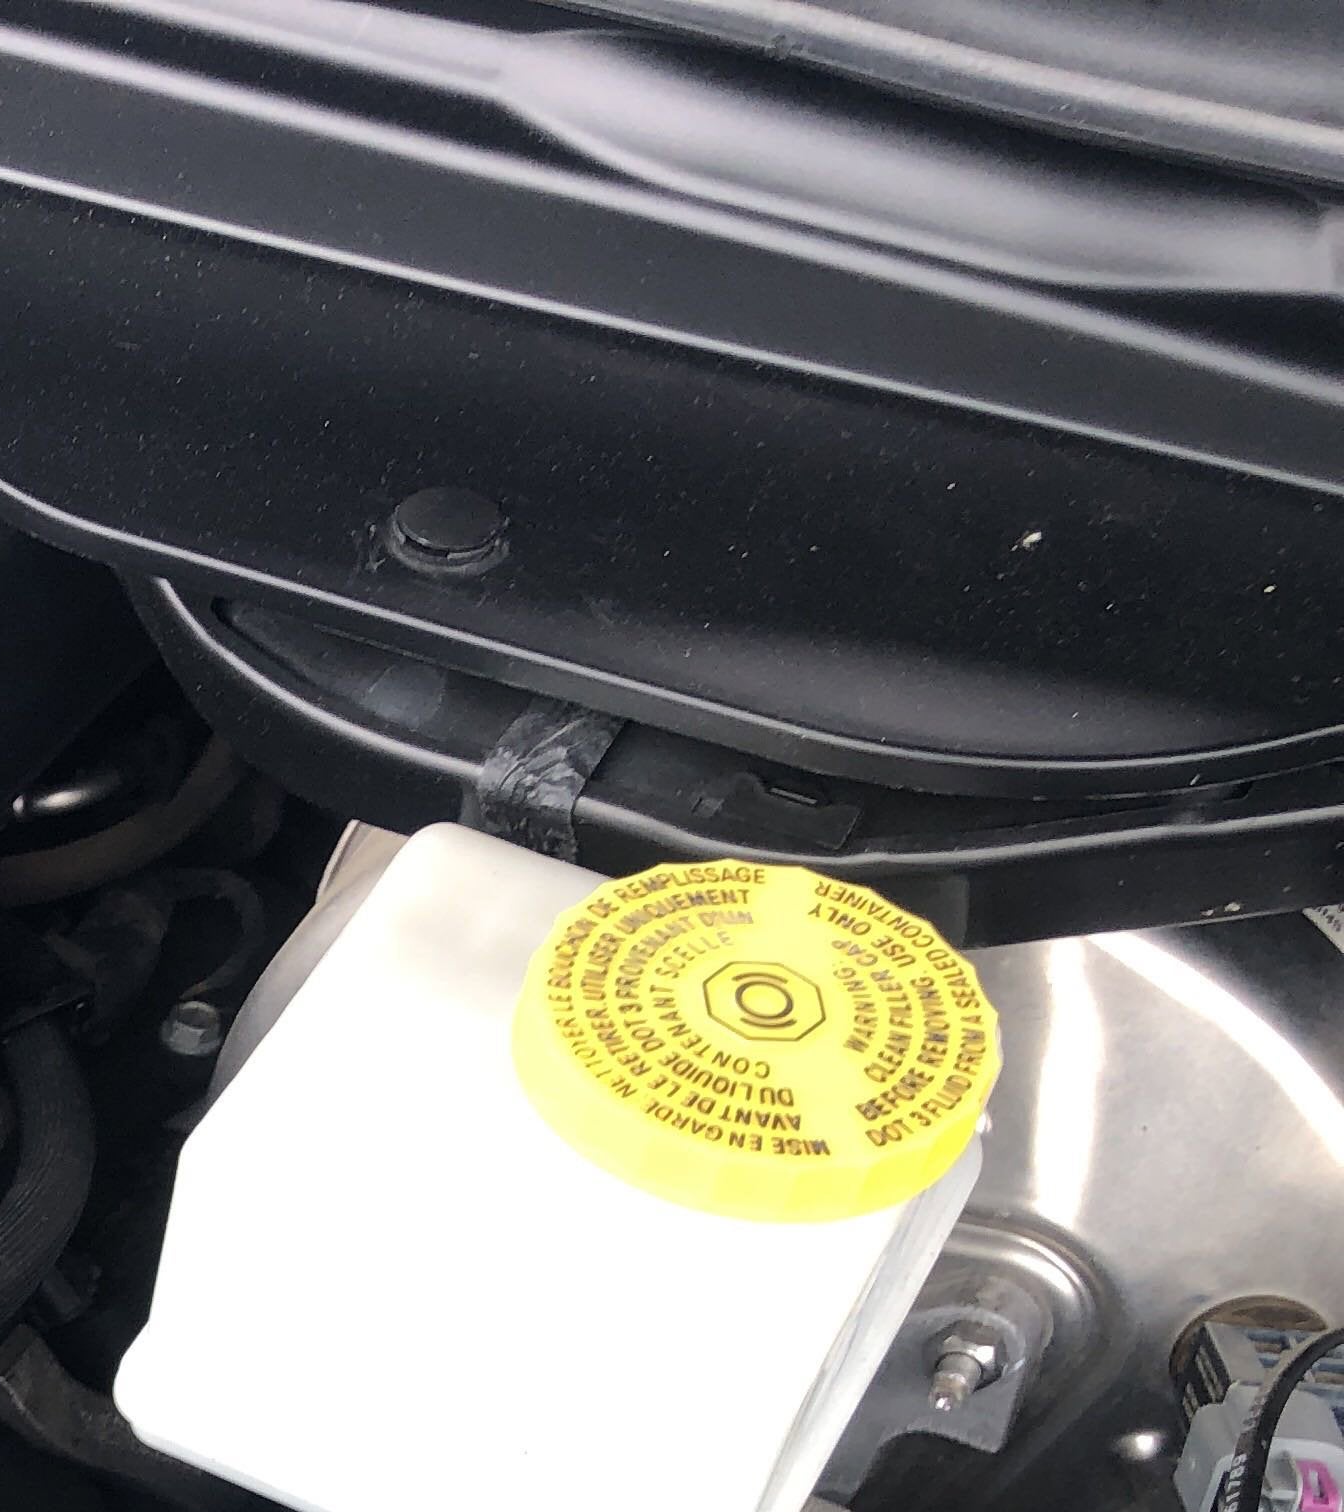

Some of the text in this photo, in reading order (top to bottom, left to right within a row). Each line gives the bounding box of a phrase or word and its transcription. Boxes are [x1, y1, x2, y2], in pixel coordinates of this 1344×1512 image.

[612, 867, 767, 903] REMPLISSAGE
[587, 897, 621, 919] DE
[613, 888, 750, 936] UNIQUEMENT
[808, 902, 872, 936] ONLY
[615, 915, 696, 1001] PROVENANT
[870, 935, 917, 968] USE
[548, 994, 574, 1012] LE
[618, 1002, 644, 1015] 3
[814, 880, 986, 1147] DOT 3 FLUID FROM A SEALED CONTAINER
[831, 939, 914, 1082] CLEAN FILLER CAP
[623, 1018, 666, 1053] DOT
[649, 984, 770, 1080] CONTENANT
[648, 1074, 682, 1098] LE
[658, 1050, 753, 1101] LIQUIDE
[680, 1090, 717, 1116] DE
[759, 1086, 795, 1108] DU
[855, 1067, 936, 1121] BEFORE
[722, 1104, 802, 1131] AVANT
[728, 1131, 763, 1151] EN
[771, 1136, 831, 1156] MISE
